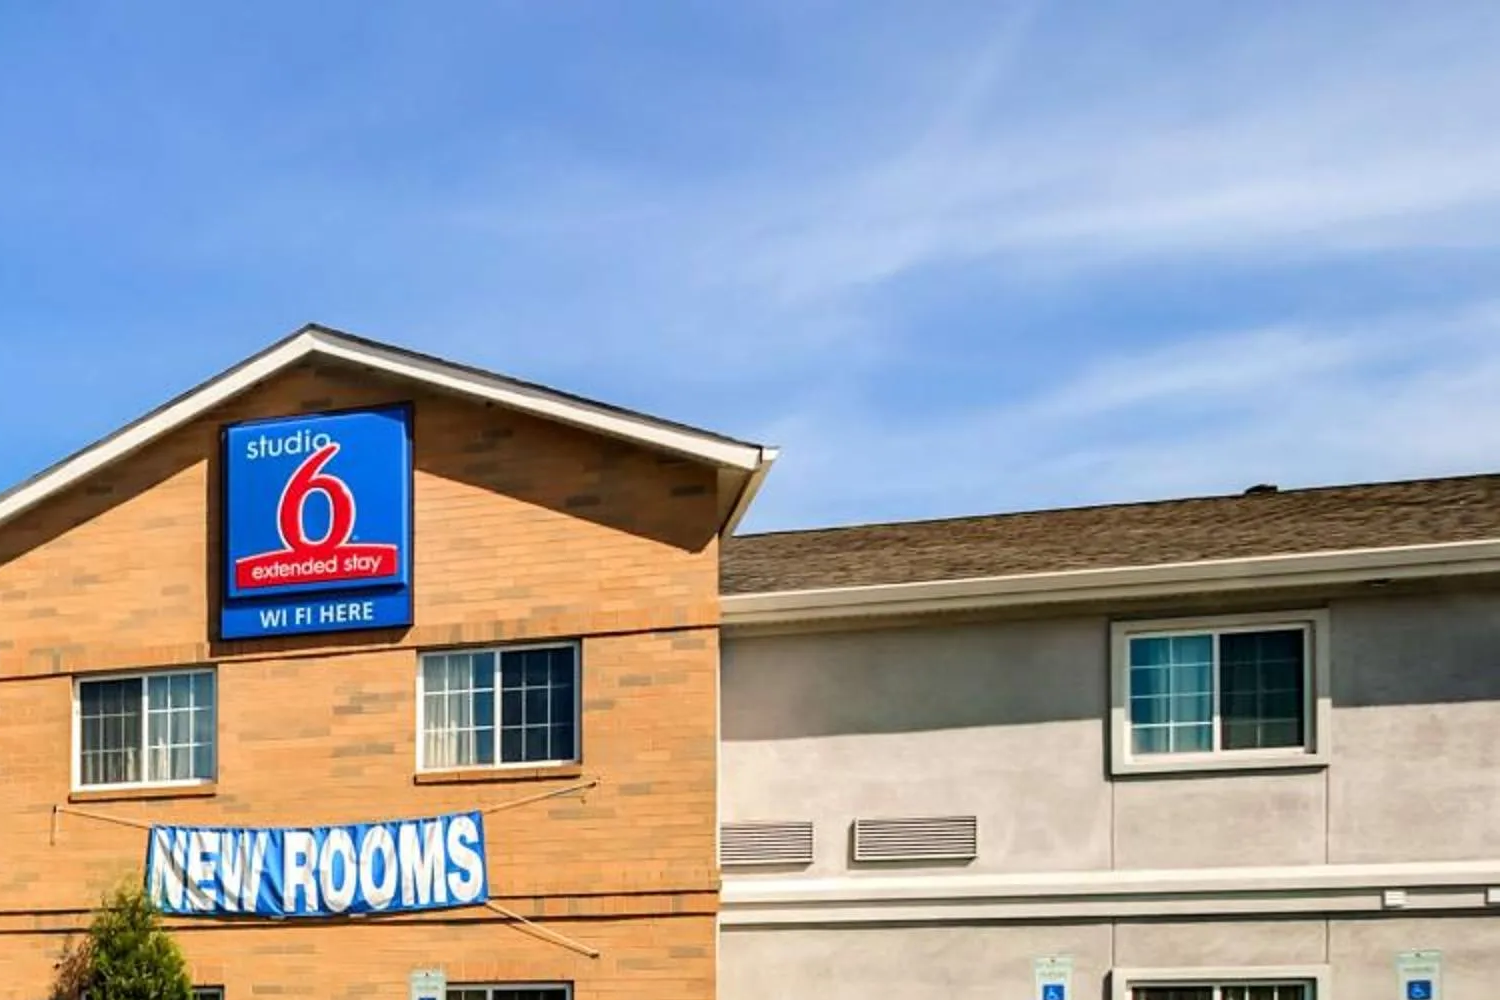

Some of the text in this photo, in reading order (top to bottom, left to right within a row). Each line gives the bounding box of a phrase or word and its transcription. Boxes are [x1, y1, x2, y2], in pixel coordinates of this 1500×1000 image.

[247, 429, 331, 460] studio
[277, 442, 356, 551] 6
[252, 553, 383, 580] extended stay
[260, 602, 374, 629] WI FI HERE
[151, 816, 483, 913] NEW ROOMS
